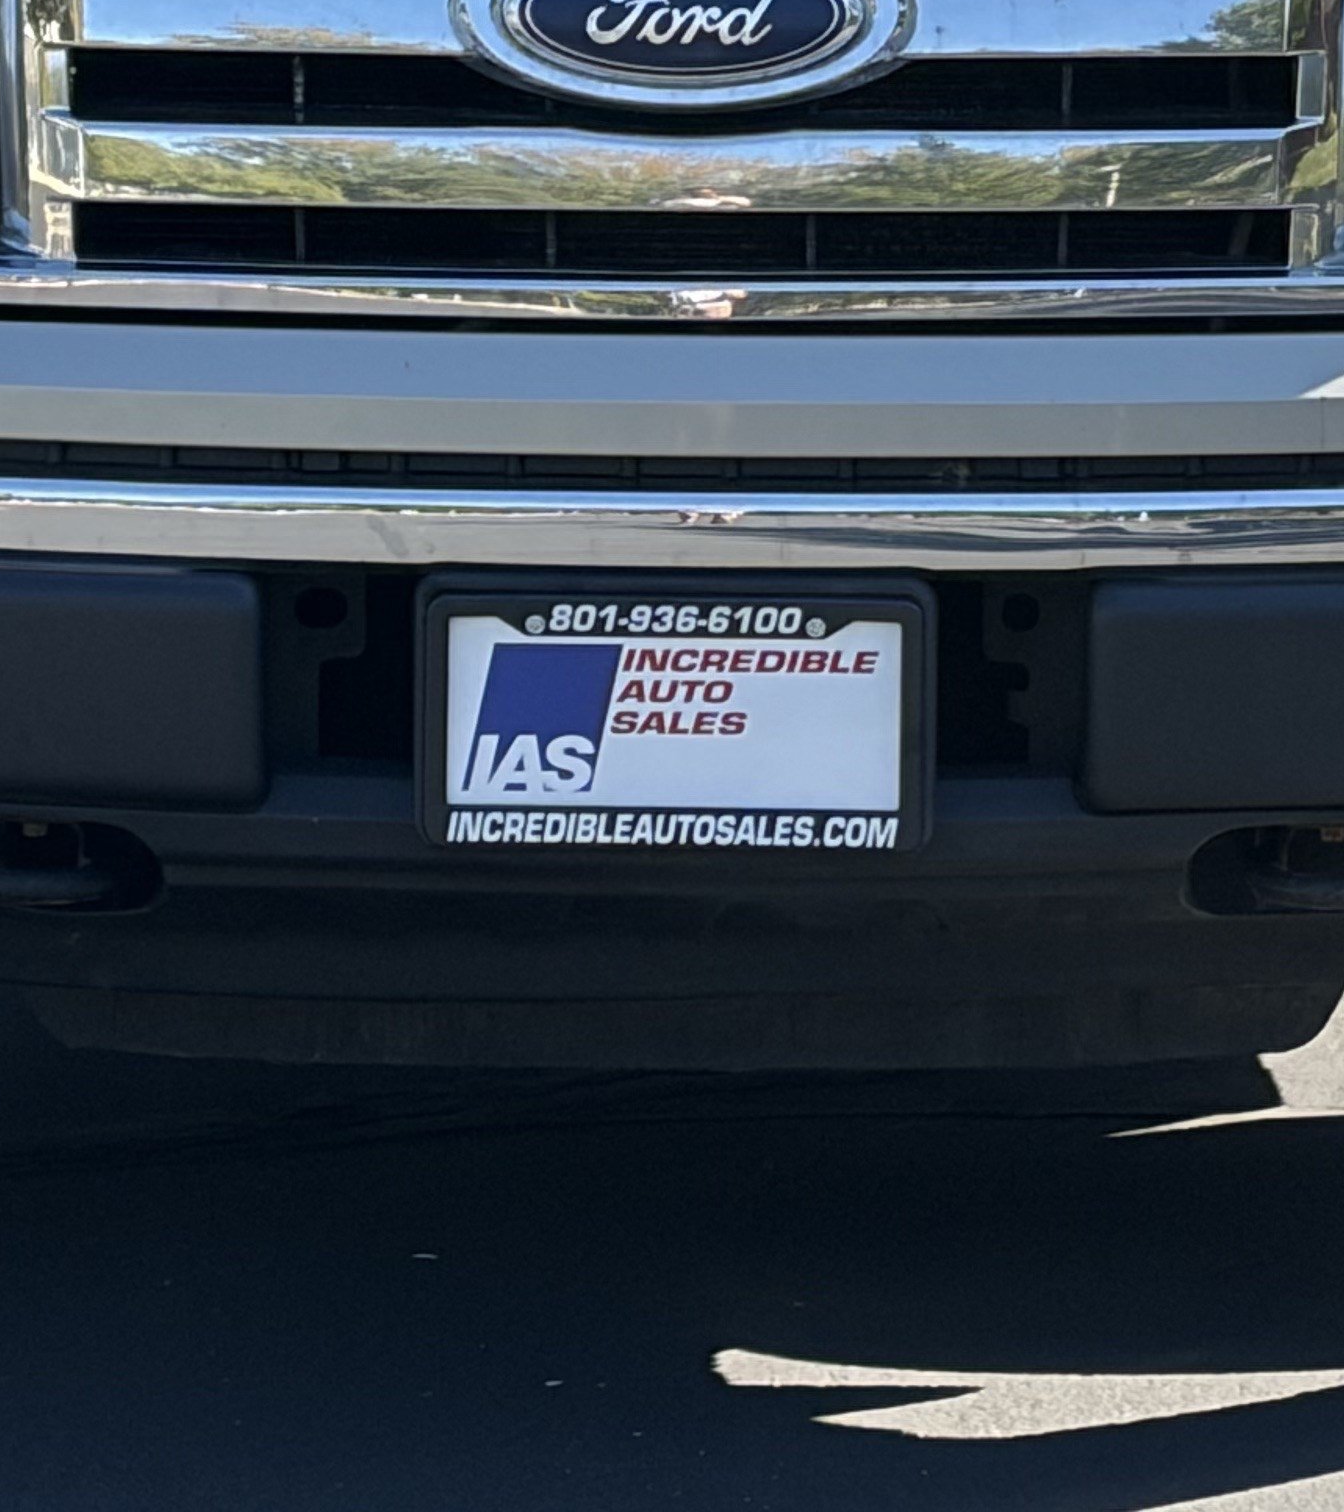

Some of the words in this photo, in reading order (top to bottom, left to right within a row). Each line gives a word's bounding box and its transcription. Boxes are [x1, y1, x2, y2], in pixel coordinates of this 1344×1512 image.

[548, 604, 802, 635] 801-936-6100
[622, 649, 879, 674] INCREDIBLE
[616, 680, 734, 702] AUTO
[610, 711, 747, 734] SALES
[468, 734, 596, 792] IAS
[446, 811, 899, 849] INCREDIBLEAUTOSALES.COM
